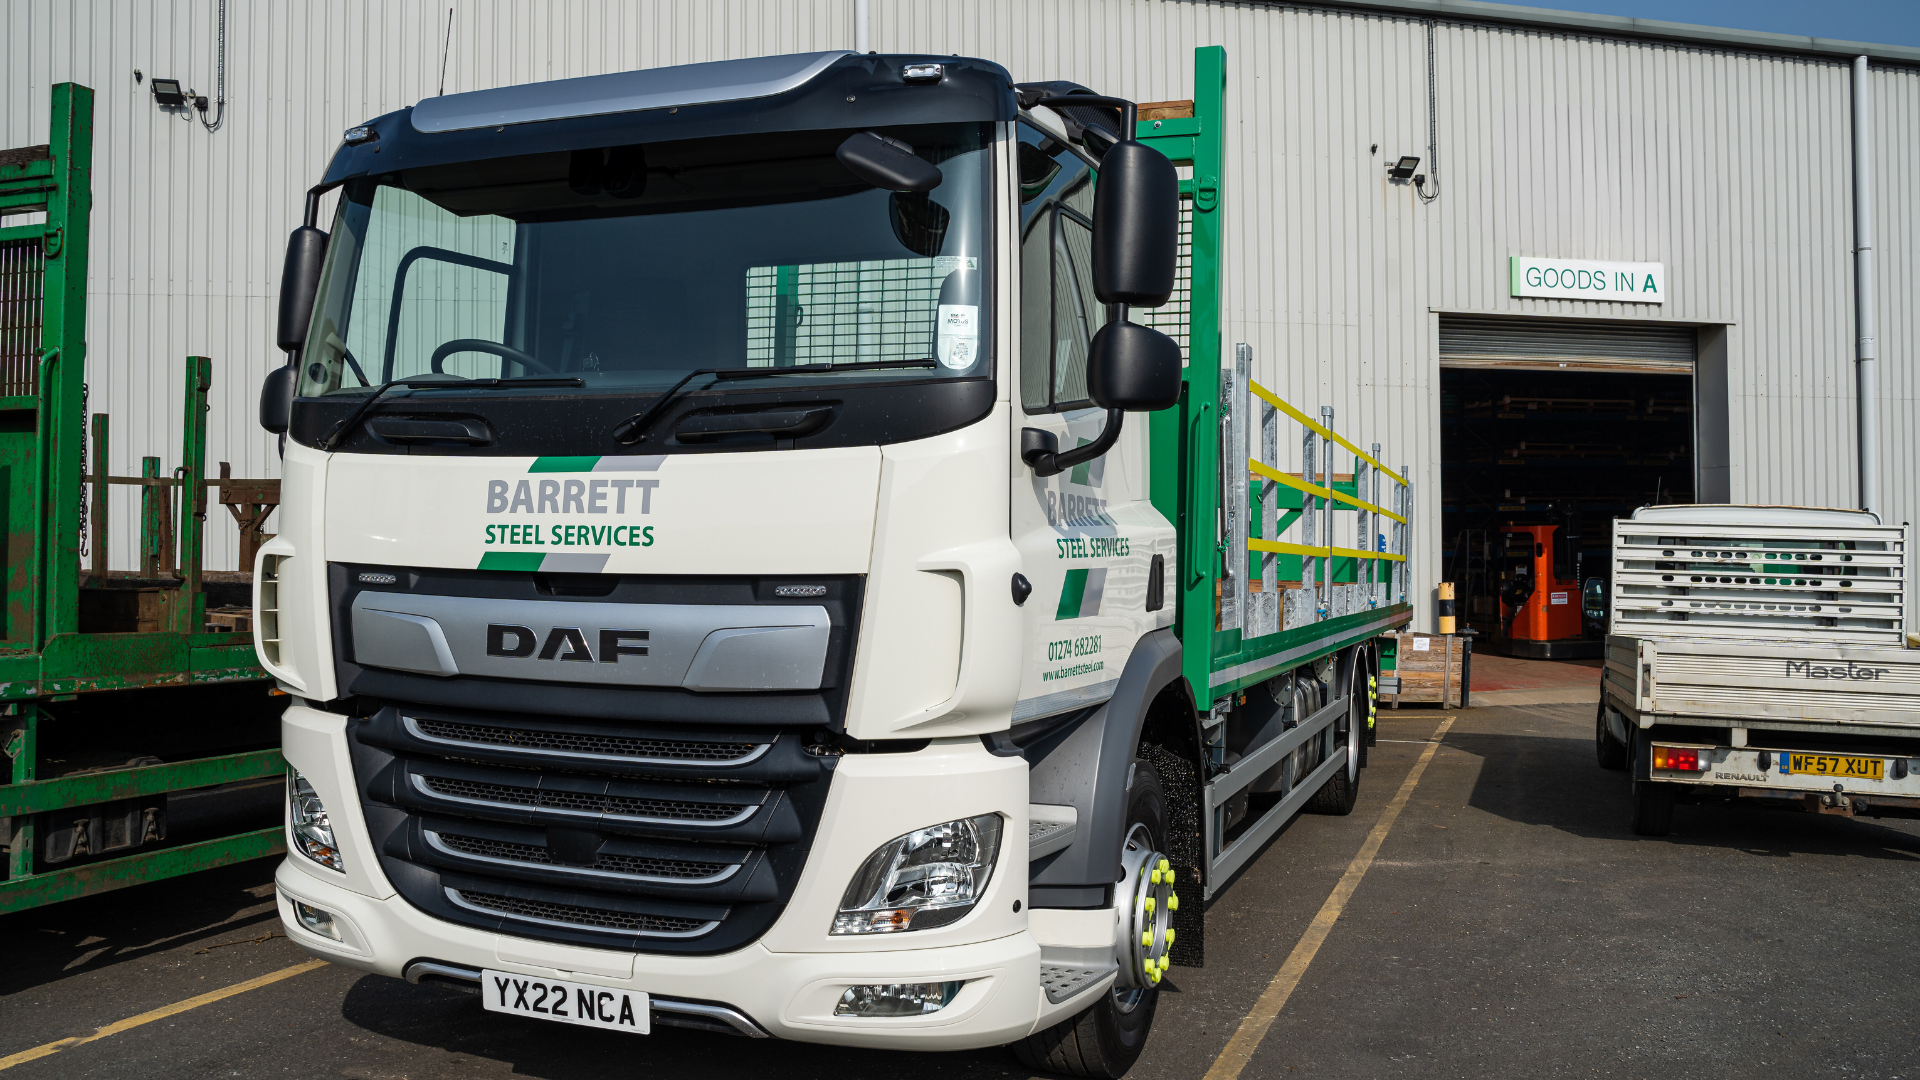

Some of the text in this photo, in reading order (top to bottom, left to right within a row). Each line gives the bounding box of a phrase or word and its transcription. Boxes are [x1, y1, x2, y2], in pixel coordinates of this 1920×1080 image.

[1526, 267, 1658, 293] GOODS IN A
[486, 479, 660, 515] BARRETT
[1047, 490, 1118, 527] BARRETT
[484, 524, 655, 547] STEEL SERVICES
[1056, 537, 1130, 559] STEEL SERVICES
[486, 623, 651, 664] DAF
[1048, 634, 1102, 661] 01274 682281
[1042, 660, 1104, 682] www.barrettsteel.com
[1785, 660, 1891, 680] Master
[1715, 771, 1769, 783] RENAULT
[1792, 755, 1881, 776] WF57 XUT
[494, 976, 636, 1027] YX22 NCA
